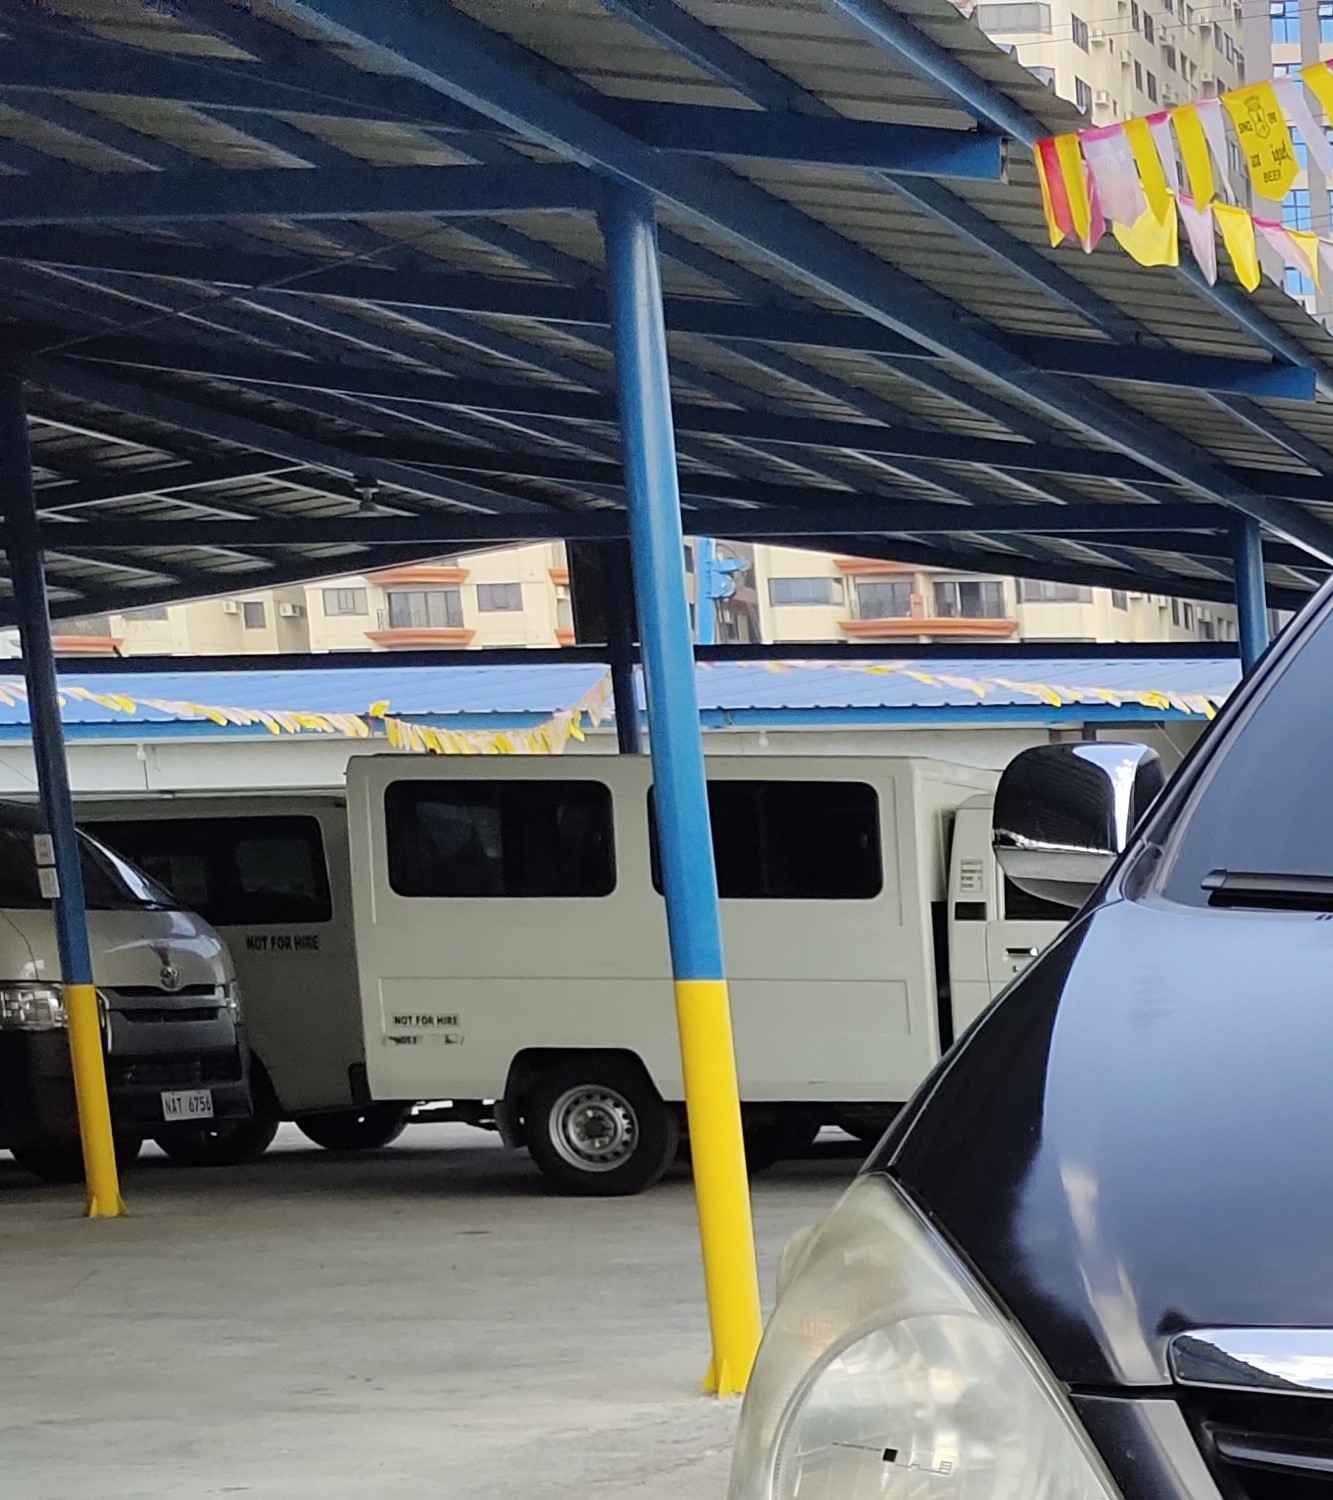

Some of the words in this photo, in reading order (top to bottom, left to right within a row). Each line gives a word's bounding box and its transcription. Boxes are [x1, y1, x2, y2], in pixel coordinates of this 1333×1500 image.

[246, 935, 268, 950] NOT
[271, 935, 292, 950] FOR
[294, 935, 320, 950] HIRE
[394, 1015, 412, 1025] NOT
[416, 1015, 434, 1025] FOR
[437, 1015, 458, 1026] HIRE
